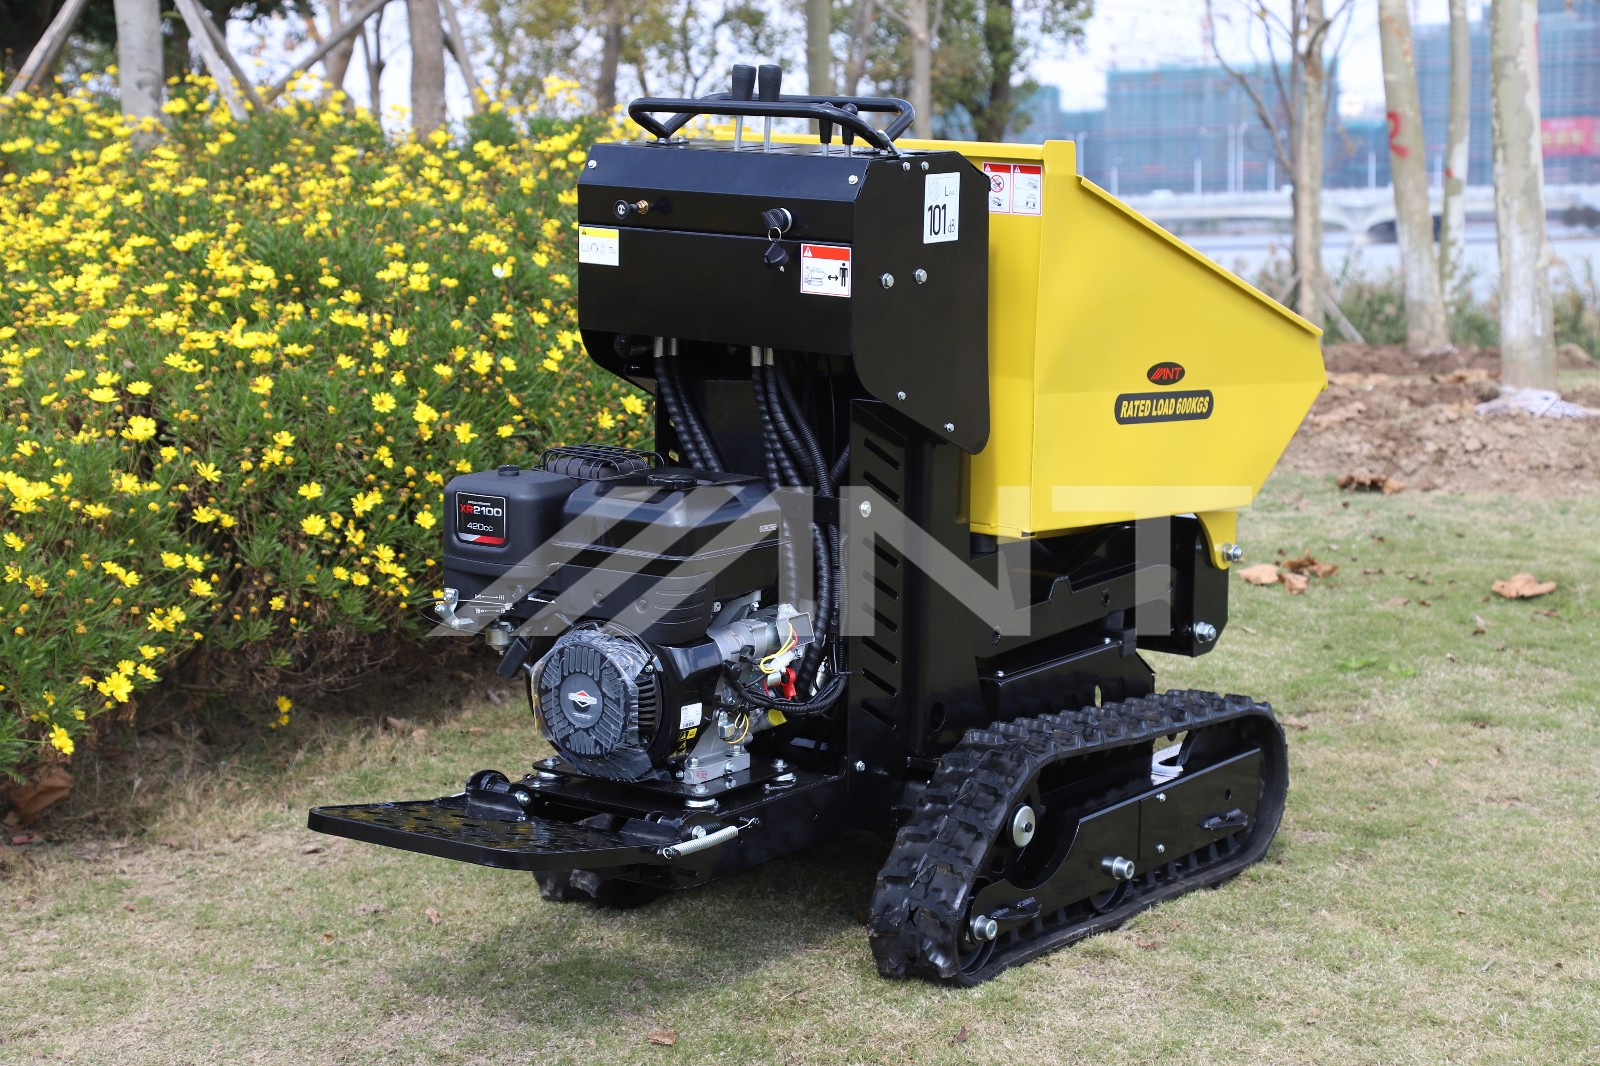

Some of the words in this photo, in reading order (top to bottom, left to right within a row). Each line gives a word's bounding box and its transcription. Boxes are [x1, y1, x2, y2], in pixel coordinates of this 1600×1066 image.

[928, 203, 947, 236] 101
[1120, 400, 1151, 417] RATED
[1152, 398, 1175, 416] LOAD
[1176, 396, 1210, 415] 600KGS
[460, 504, 502, 516] XR2100
[467, 522, 493, 531] 420cc
